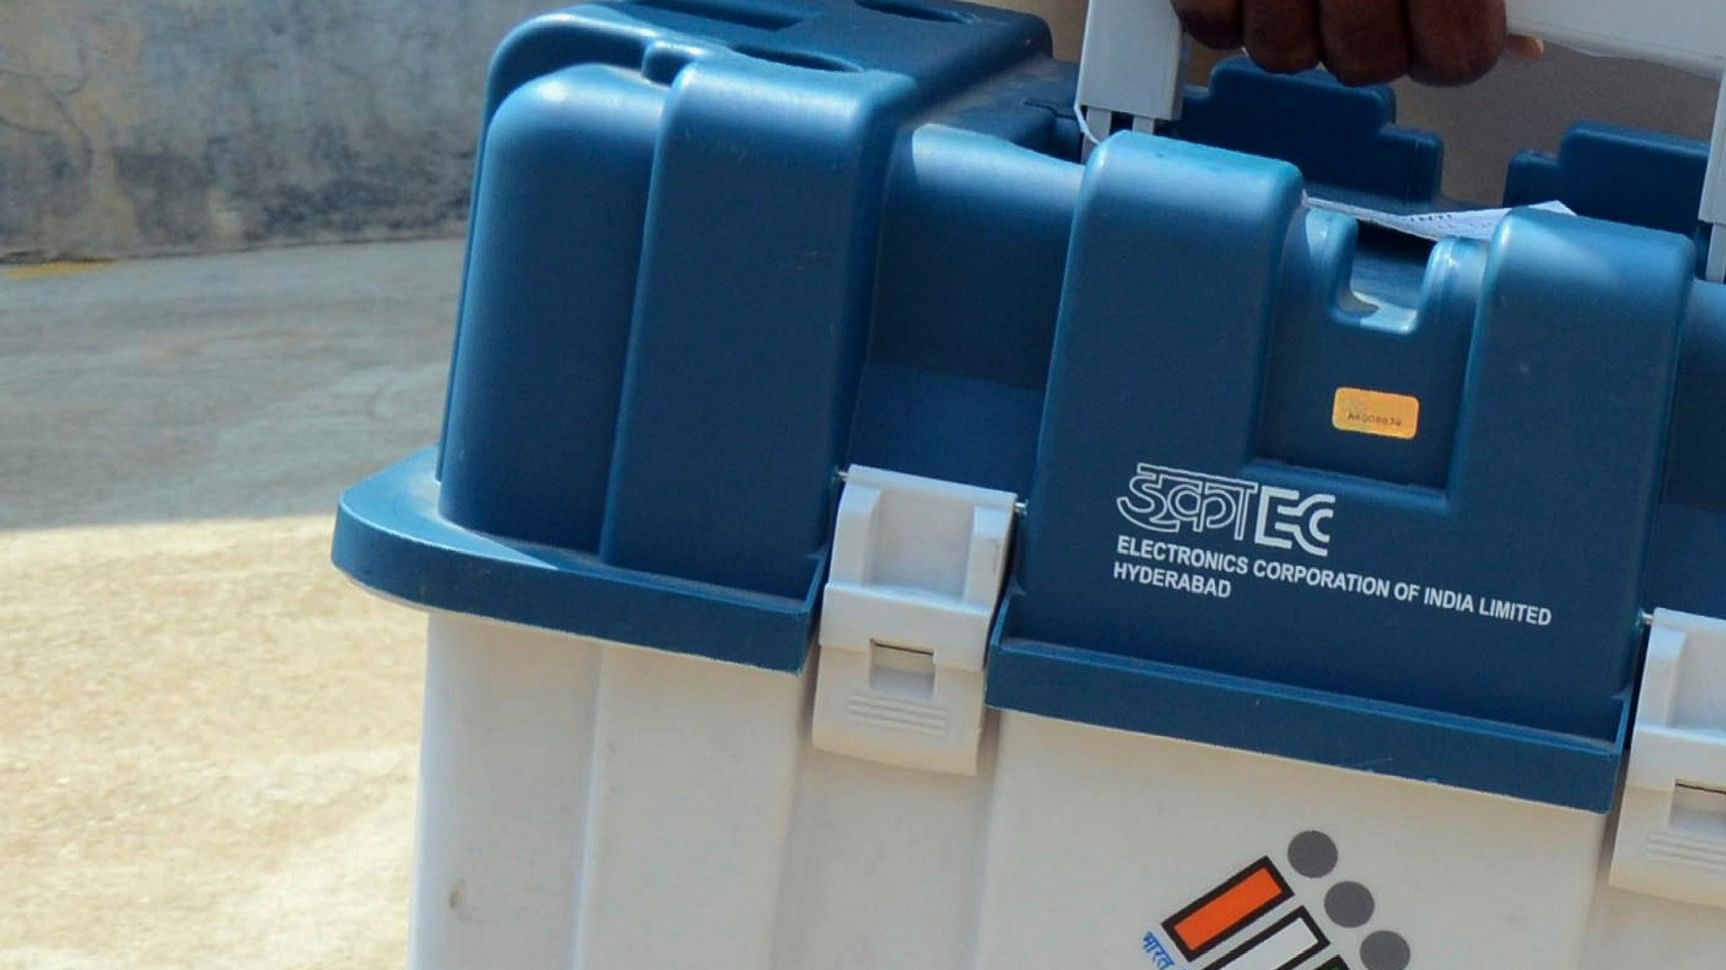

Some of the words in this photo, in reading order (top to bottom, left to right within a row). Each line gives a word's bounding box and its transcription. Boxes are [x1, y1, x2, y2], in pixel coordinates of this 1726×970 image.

[1113, 561, 1231, 598] HYDERABAD
[1117, 535, 1249, 574] ELECTRONICS
[1253, 559, 1390, 598] CORPORATION
[1394, 582, 1420, 602] OF
[1424, 587, 1474, 613] INDIA
[1479, 598, 1552, 626] LIMITED
[1143, 931, 1174, 970] भारत
